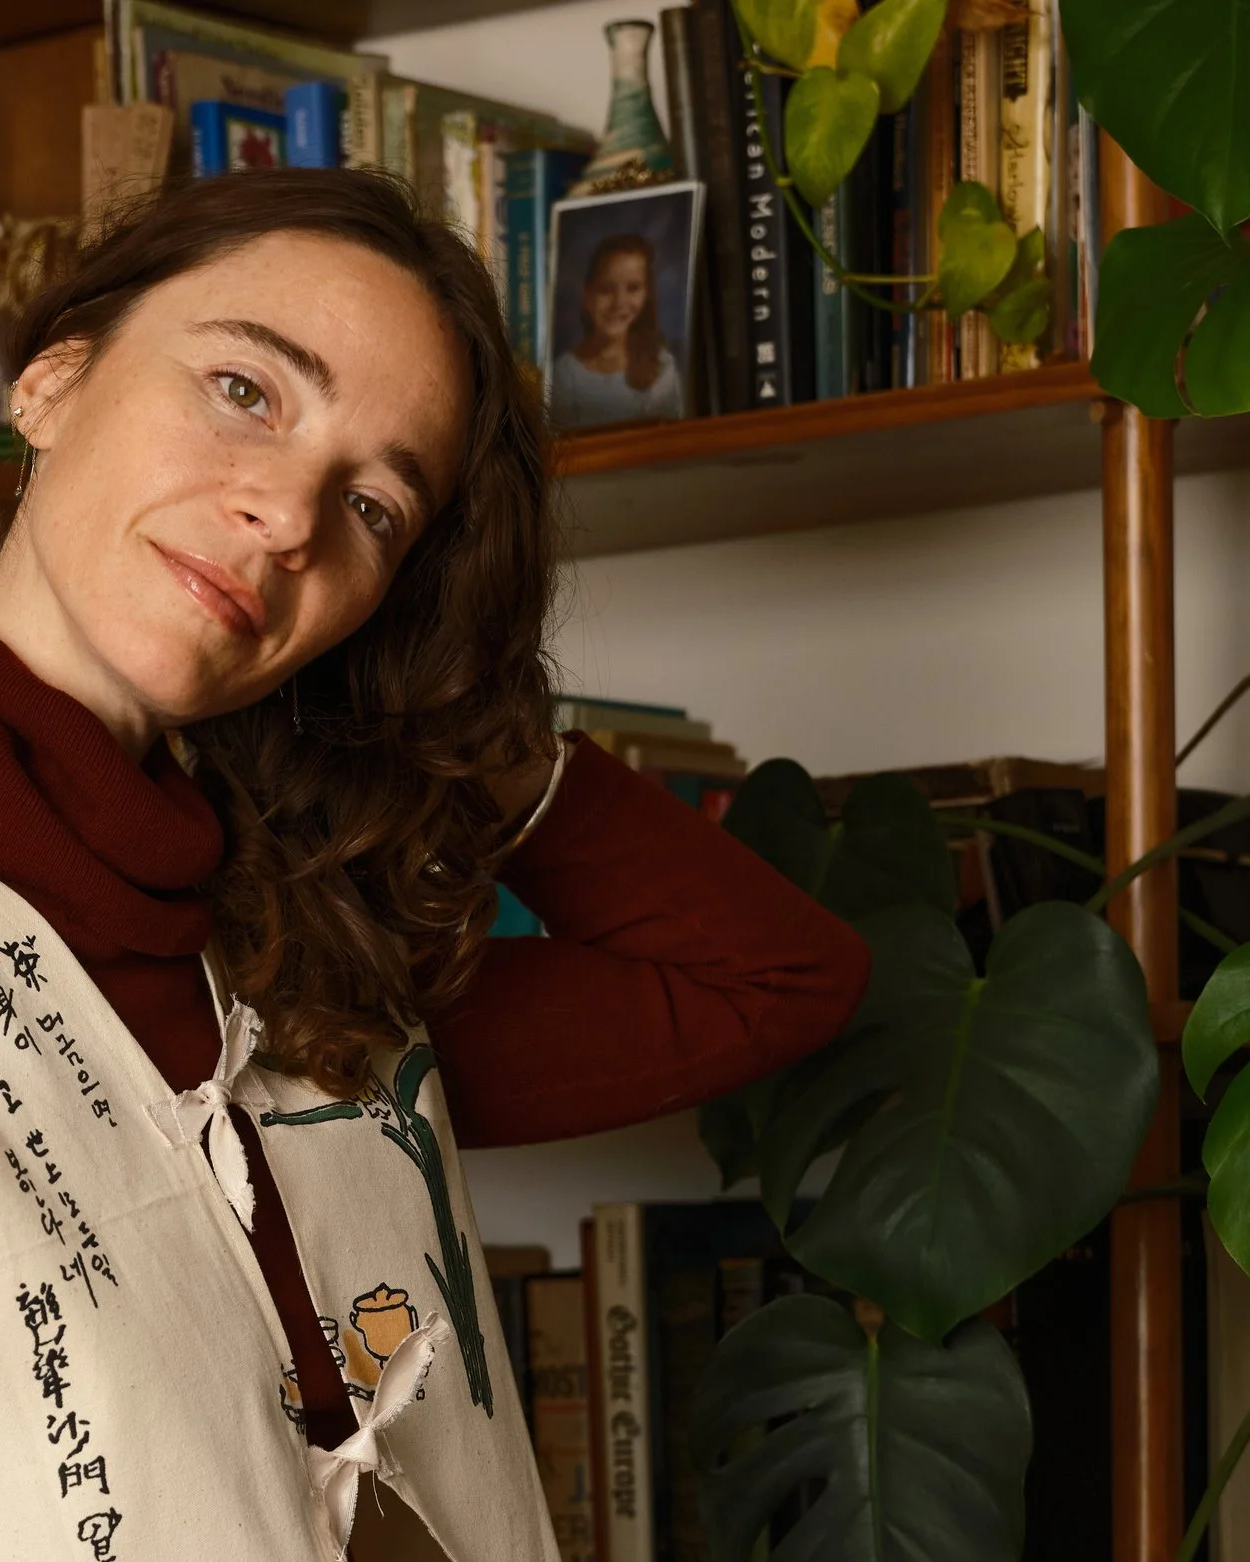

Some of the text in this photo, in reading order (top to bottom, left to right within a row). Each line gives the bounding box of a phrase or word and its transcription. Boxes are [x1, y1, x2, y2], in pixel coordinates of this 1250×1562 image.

[742, 43, 767, 180] erican
[748, 192, 778, 322] Modern
[607, 1305, 640, 1402] Gothic
[611, 1411, 642, 1520] Europe
